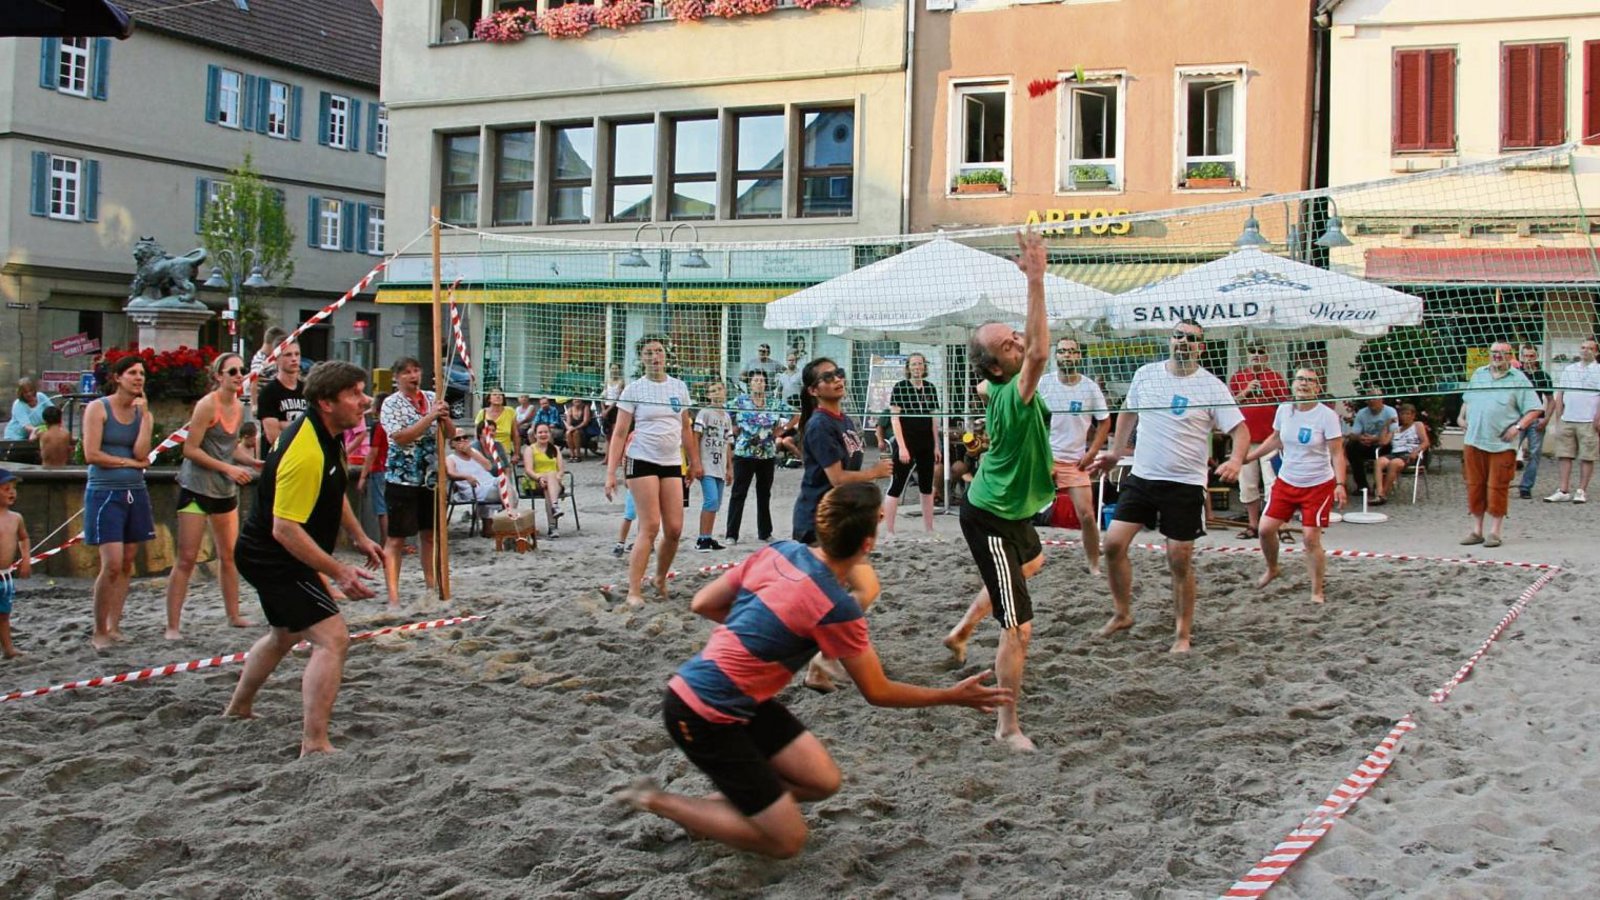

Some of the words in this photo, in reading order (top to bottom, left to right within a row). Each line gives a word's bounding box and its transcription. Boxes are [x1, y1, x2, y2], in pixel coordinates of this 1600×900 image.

[1022, 207, 1132, 235] ARTOS
[1133, 302, 1259, 322] SANWALD
[1309, 302, 1377, 320] Weizen
